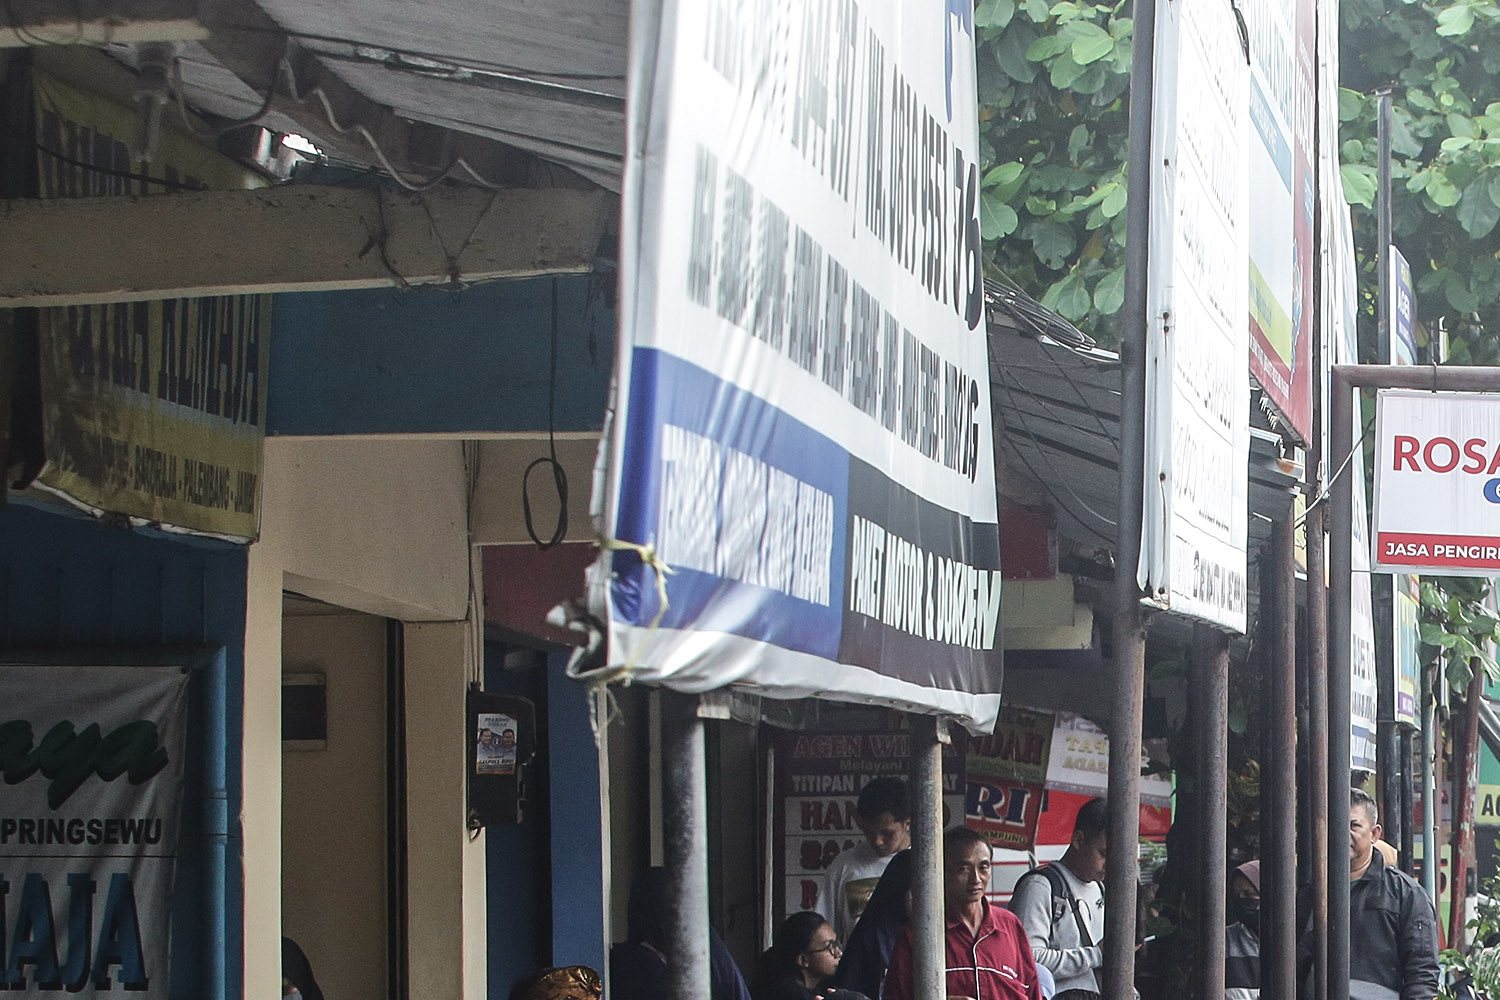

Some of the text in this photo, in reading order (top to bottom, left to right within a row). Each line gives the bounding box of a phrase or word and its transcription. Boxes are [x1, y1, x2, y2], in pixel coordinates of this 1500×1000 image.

[920, 105, 949, 305] 9551
[850, 514, 885, 623] PAKET
[882, 531, 924, 639] MOTOR
[925, 555, 935, 642] &
[1386, 542, 1430, 559] JASA
[793, 735, 863, 758] AGEN
[1, 818, 162, 845] PRINGSEWU
[0, 872, 150, 993] AJA
